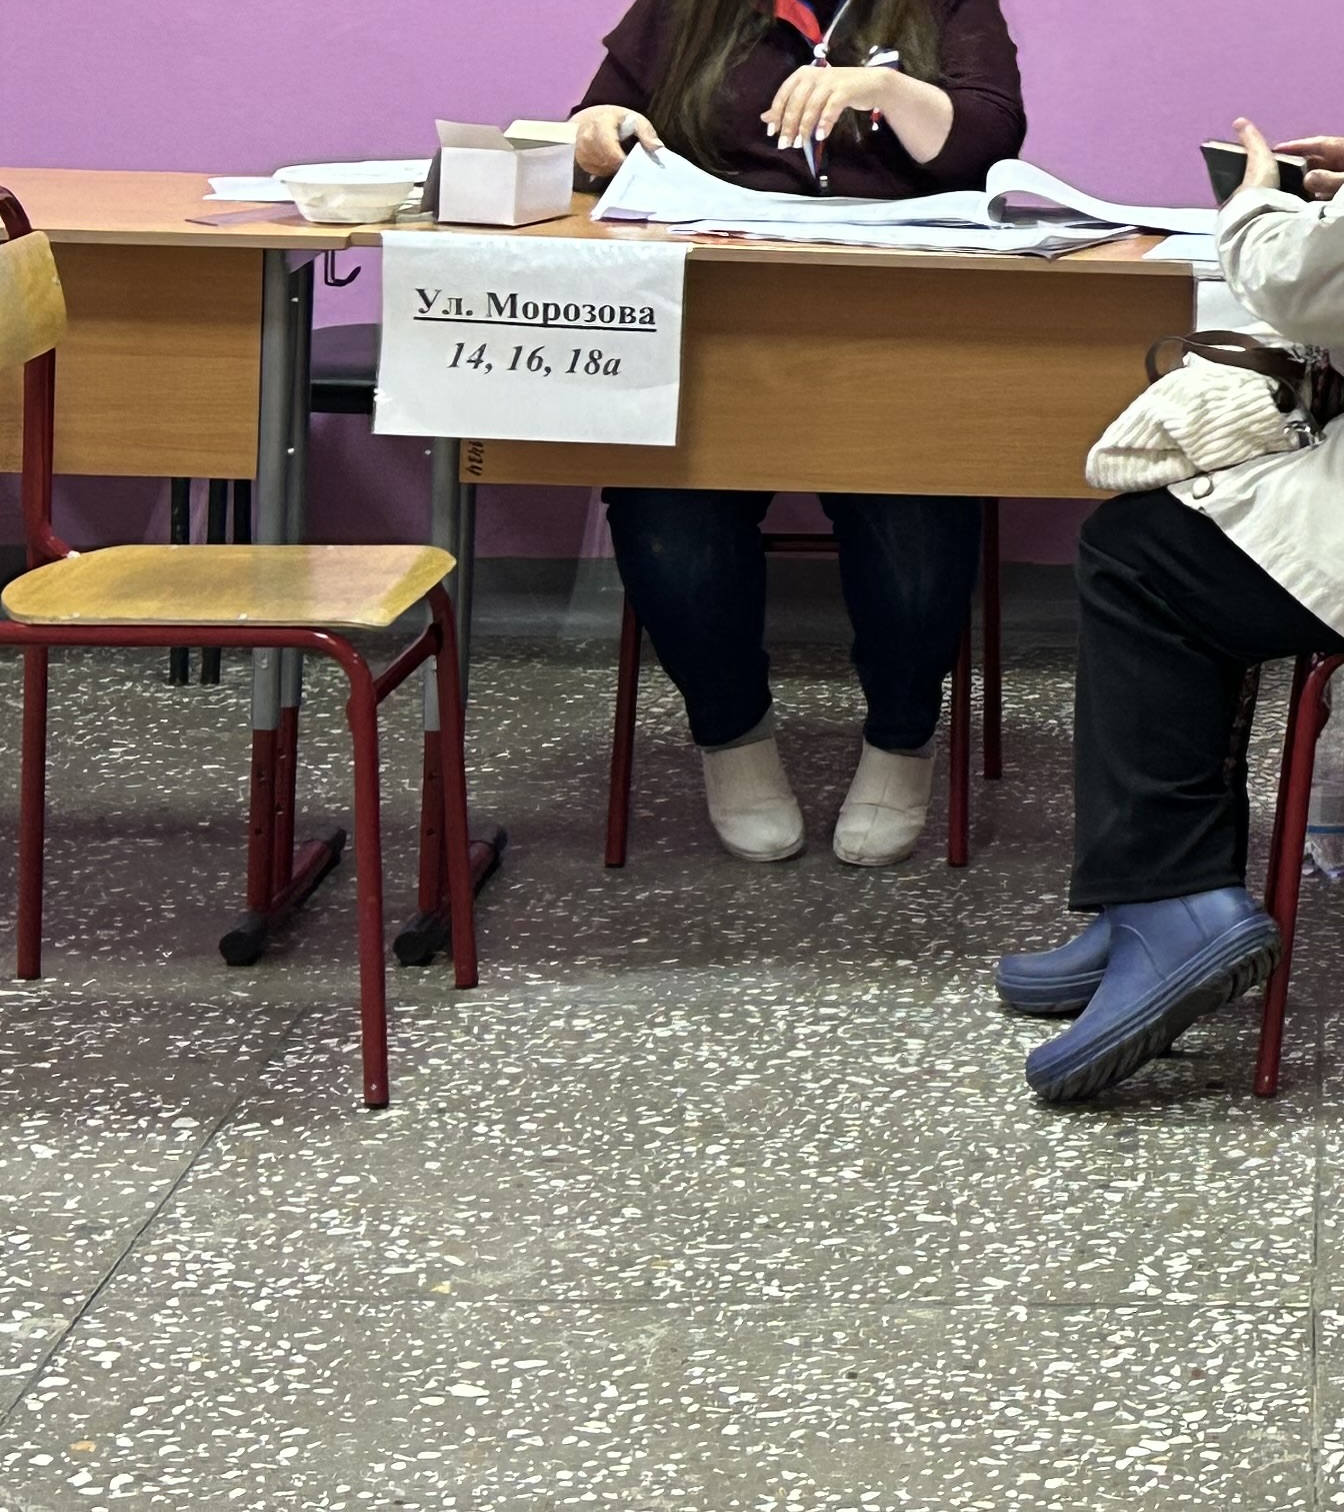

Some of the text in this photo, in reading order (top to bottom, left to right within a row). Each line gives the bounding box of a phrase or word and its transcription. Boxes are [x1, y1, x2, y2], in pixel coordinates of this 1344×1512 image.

[415, 288, 657, 326] Ул. Морозова
[447, 342, 622, 378] 14, 16, 18а
